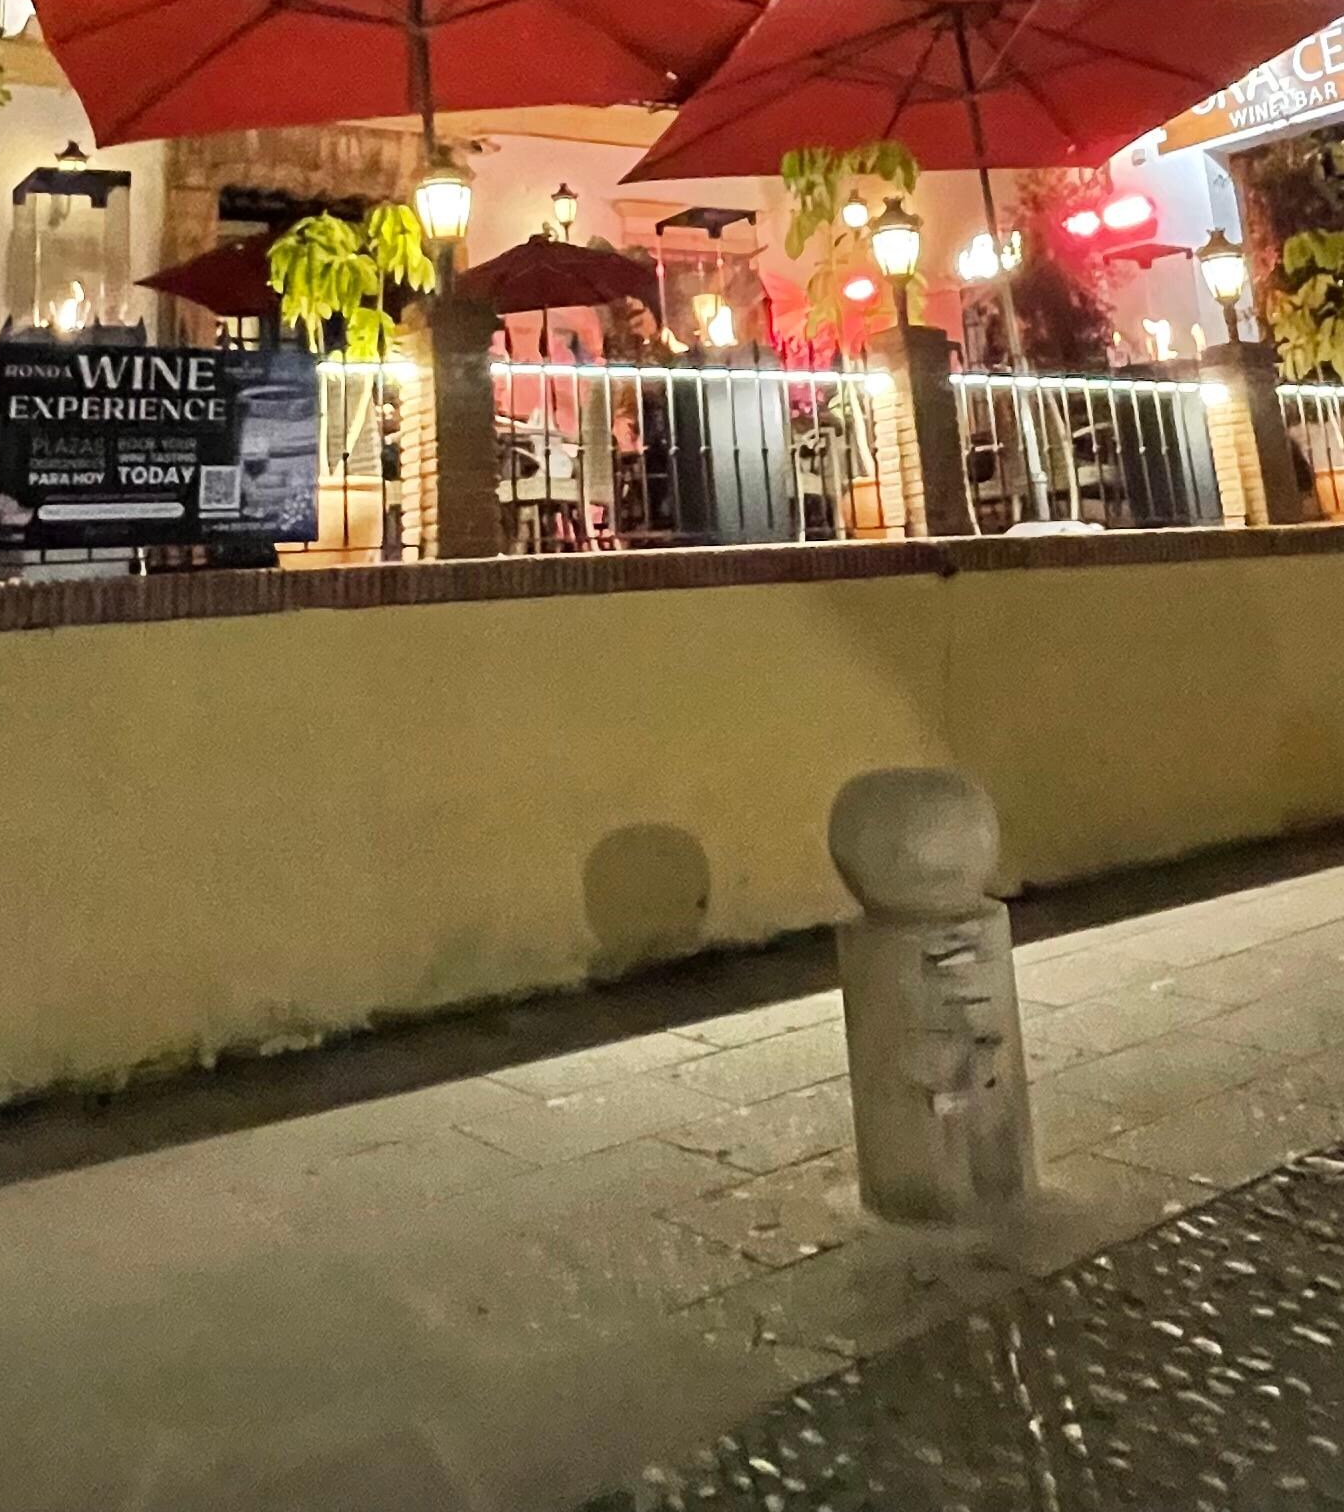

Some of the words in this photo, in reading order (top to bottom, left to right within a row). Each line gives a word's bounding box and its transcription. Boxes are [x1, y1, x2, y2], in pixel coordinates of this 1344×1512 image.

[1228, 98, 1281, 128] WINE
[1295, 81, 1338, 108] BAR
[4, 364, 74, 379] RONDA
[77, 355, 217, 391] WINE
[7, 395, 228, 422] EXPERIENCE
[28, 472, 70, 486] PARA
[72, 472, 106, 485] HOY
[117, 465, 196, 485] TODAY
